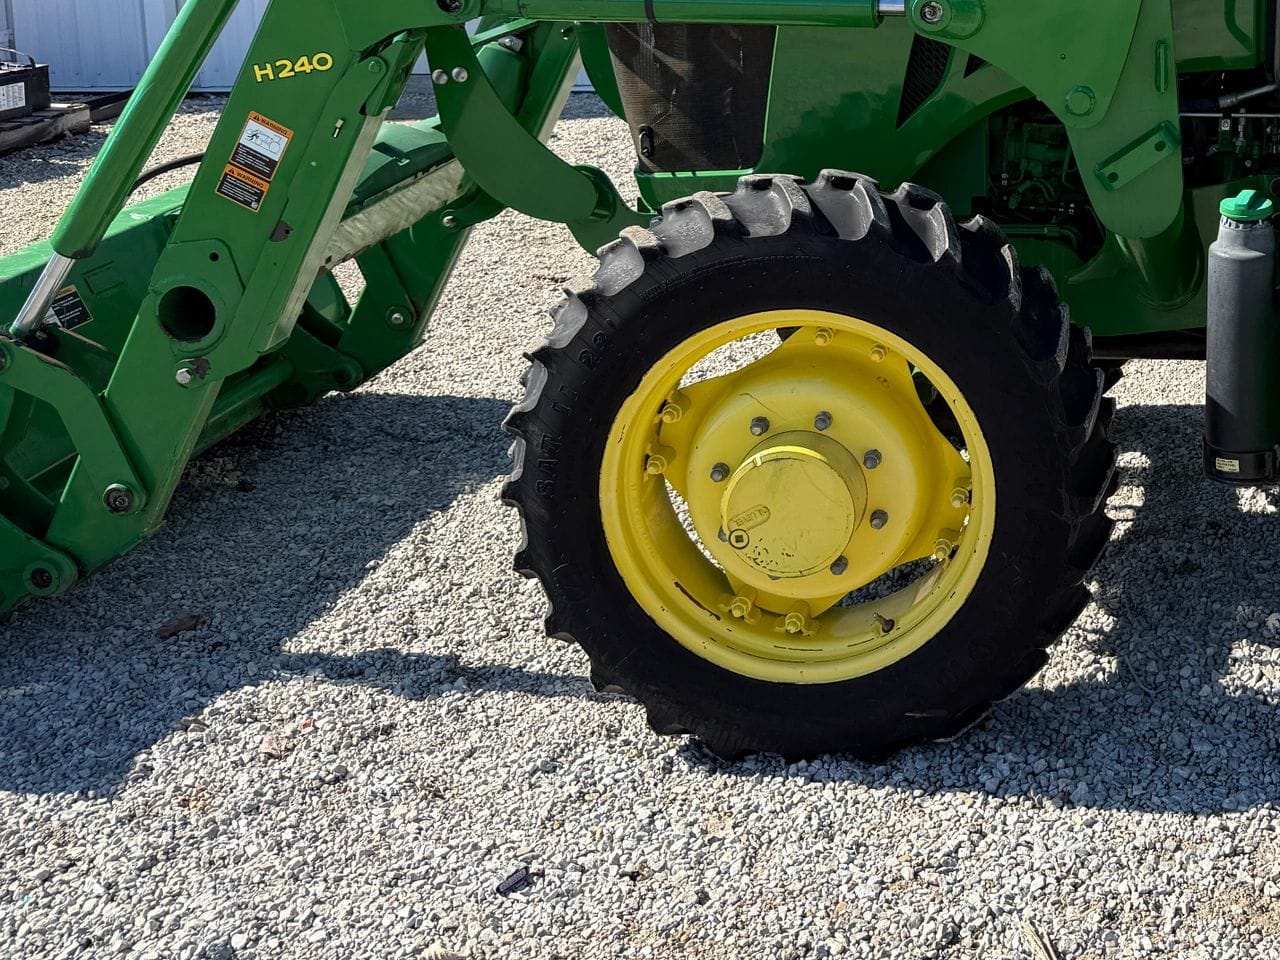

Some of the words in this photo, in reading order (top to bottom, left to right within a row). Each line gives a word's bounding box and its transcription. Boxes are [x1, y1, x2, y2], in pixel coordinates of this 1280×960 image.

[253, 52, 334, 82] H240
[260, 116, 288, 136] WARNING
[236, 171, 264, 190] WARNING
